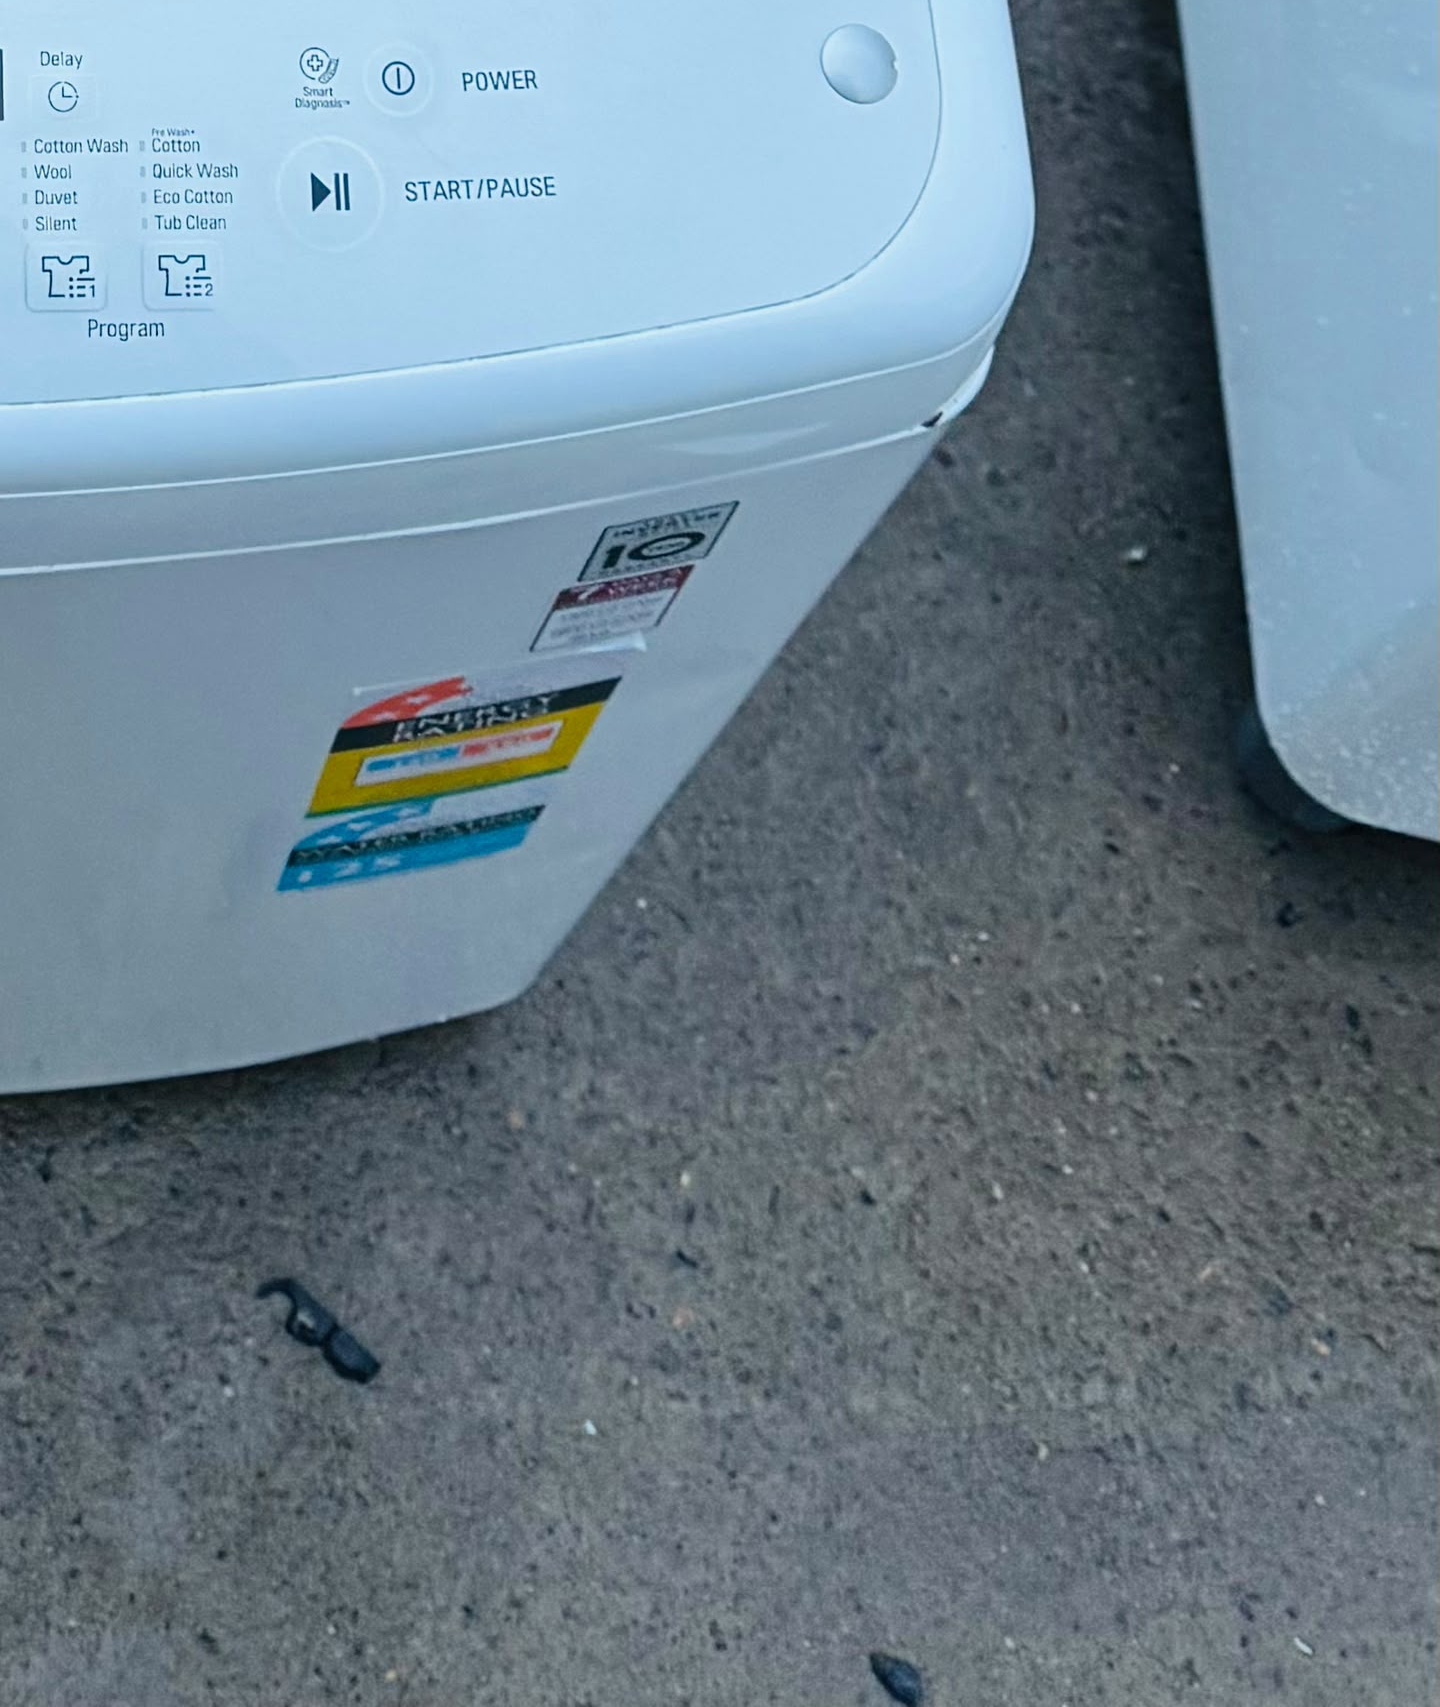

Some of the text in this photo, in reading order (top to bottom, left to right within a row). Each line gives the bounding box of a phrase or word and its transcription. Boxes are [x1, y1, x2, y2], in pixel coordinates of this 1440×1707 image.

[40, 50, 83, 70] Delay
[461, 69, 538, 92] POWER
[302, 86, 334, 97] Smart
[34, 138, 129, 154] Cotton Wash
[151, 138, 201, 153] Cotton
[33, 164, 72, 180] Wool
[152, 163, 239, 179] Quick Wash
[34, 189, 78, 205] Duvet
[154, 189, 234, 205] Eco Cotton
[404, 176, 557, 202] START/PAUSE
[35, 215, 78, 232] Silent
[154, 215, 227, 230] Tub Clean
[87, 318, 165, 342] Program
